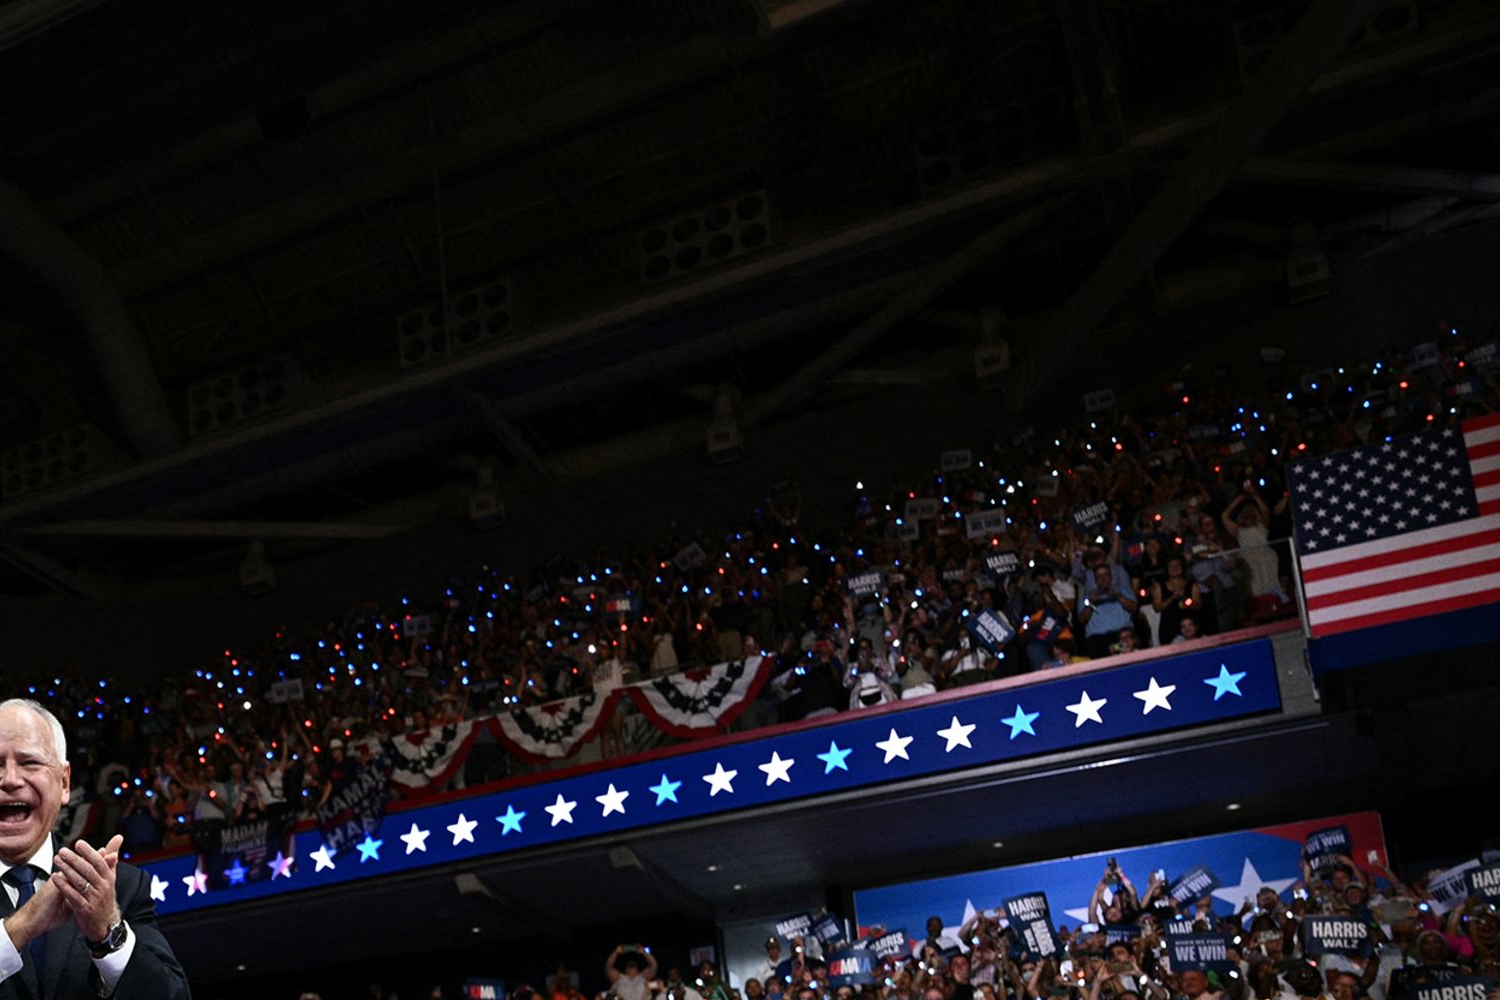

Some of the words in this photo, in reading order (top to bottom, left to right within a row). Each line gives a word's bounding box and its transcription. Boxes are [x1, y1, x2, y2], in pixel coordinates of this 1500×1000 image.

[1312, 921, 1368, 939] HARRIS
[1322, 939, 1359, 949] WALZ
[1175, 947, 1197, 962] WE
[1198, 945, 1227, 961] WIN
